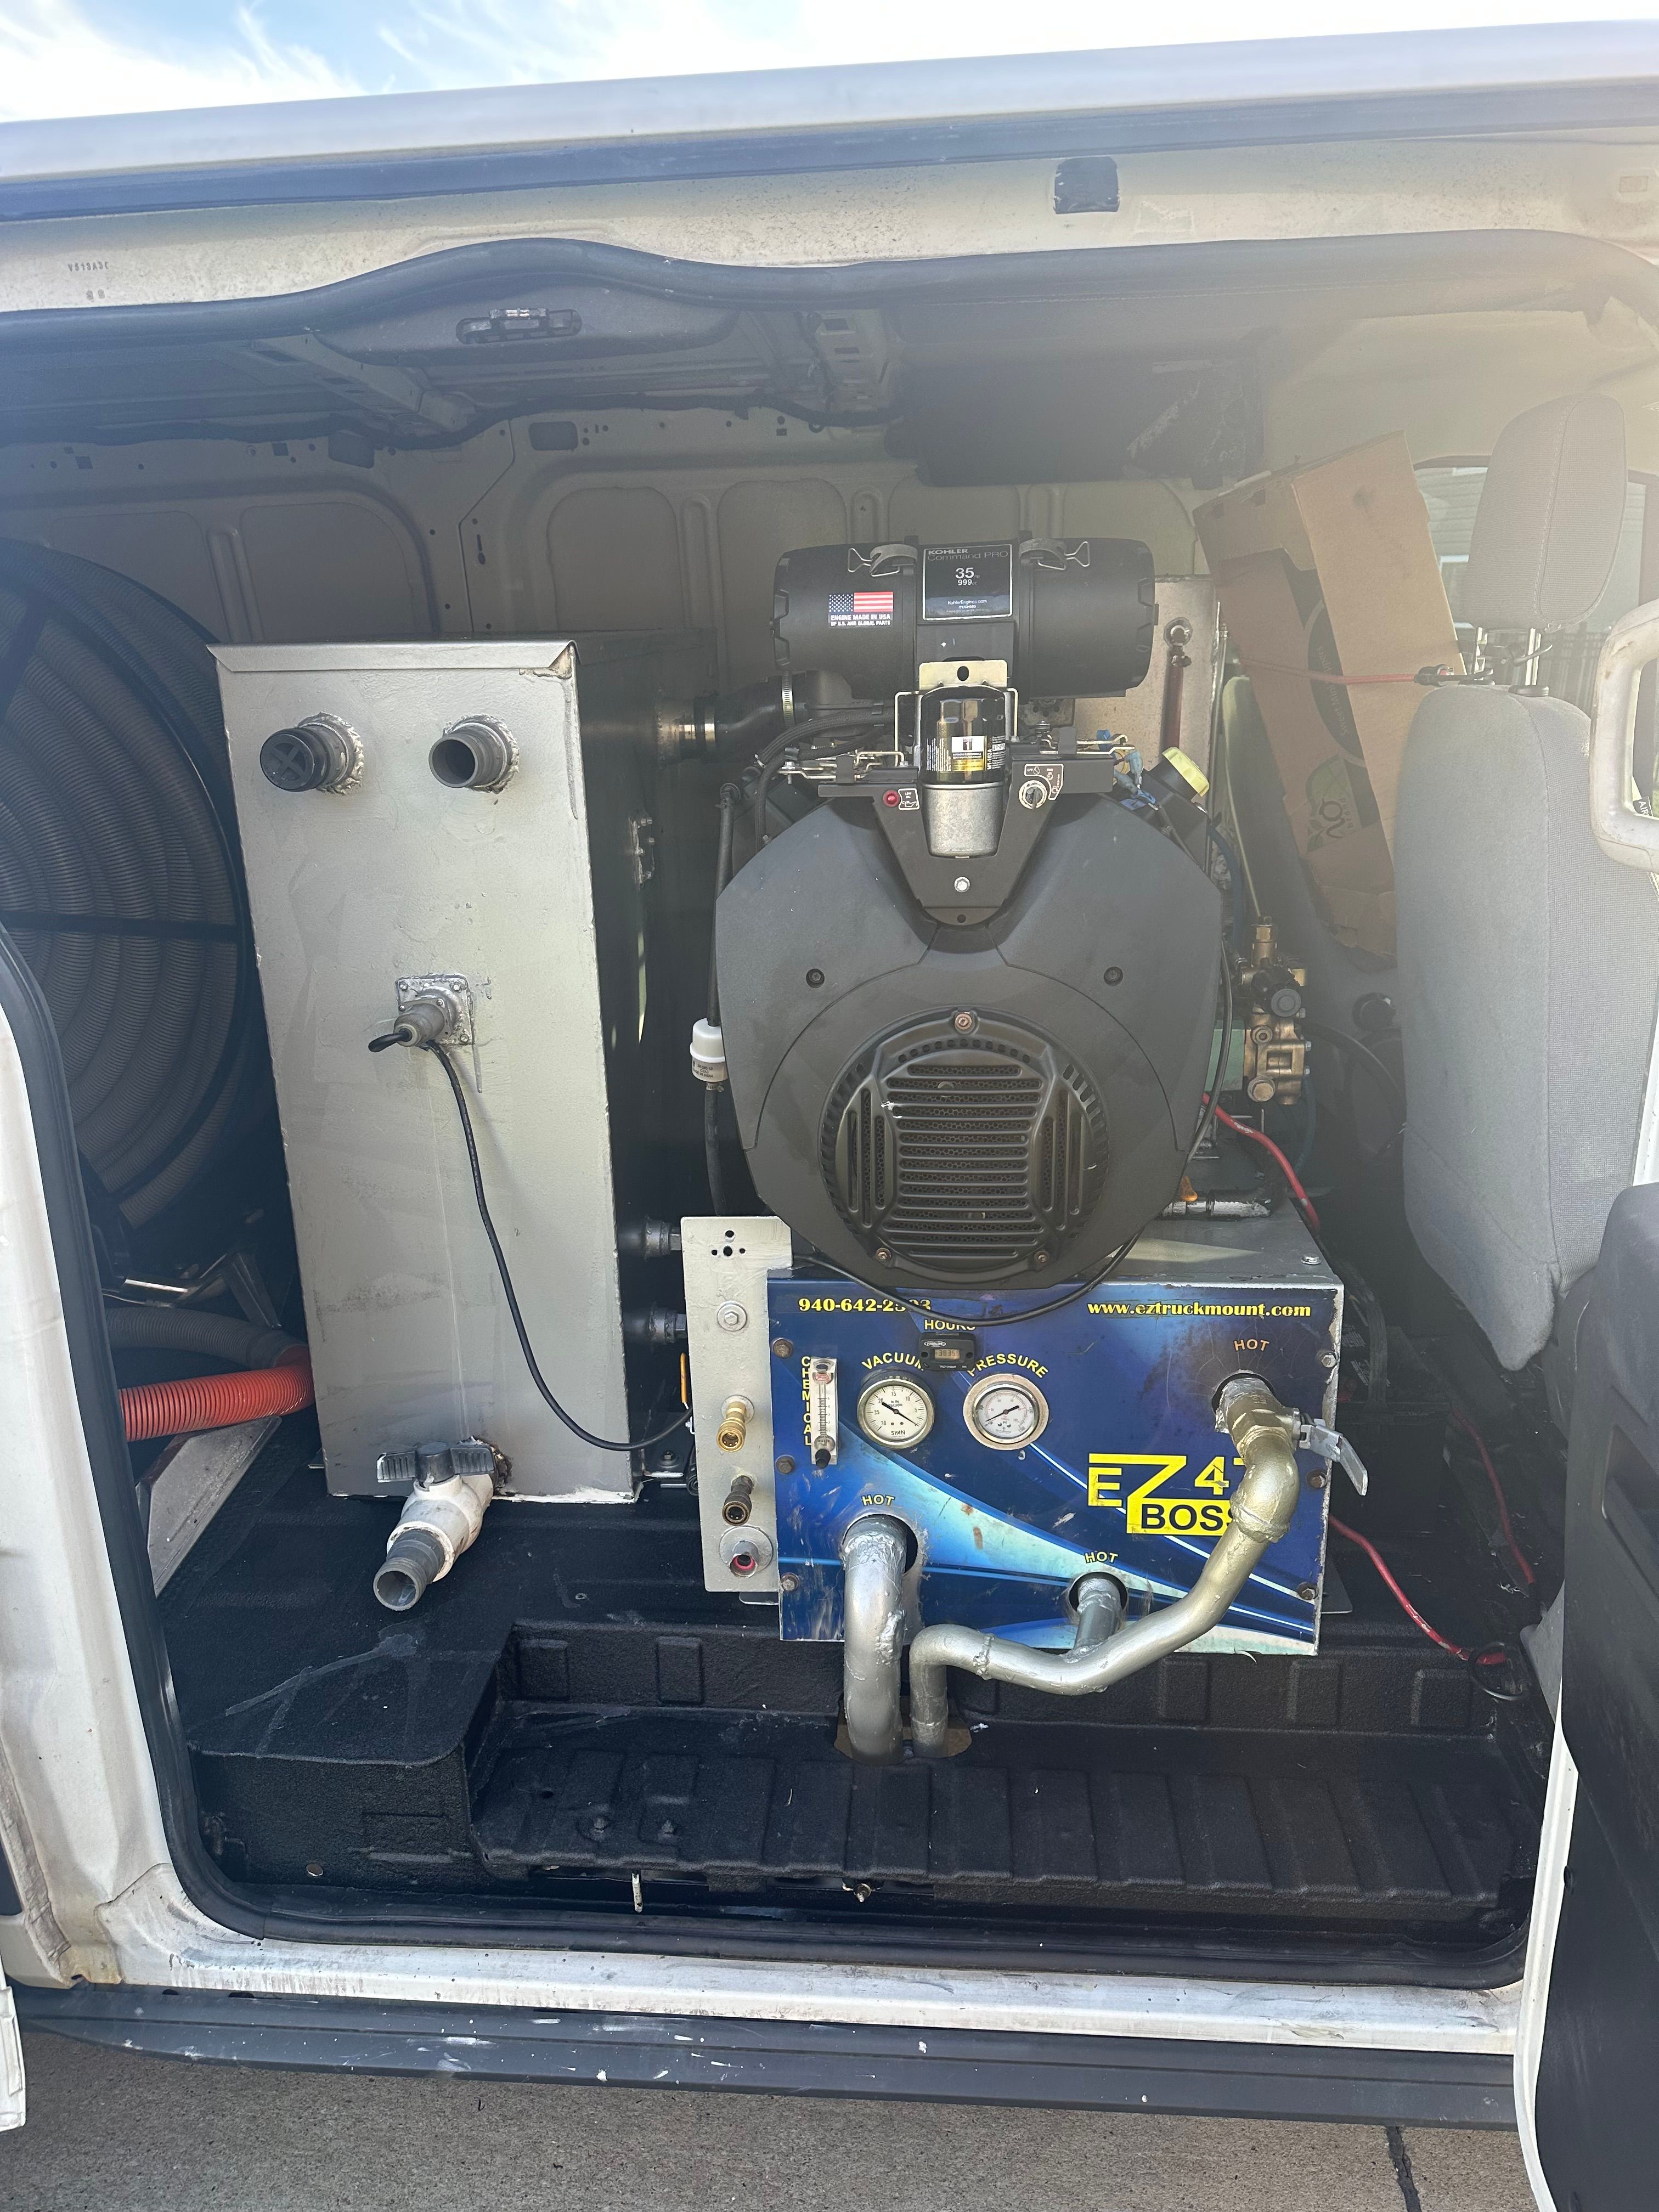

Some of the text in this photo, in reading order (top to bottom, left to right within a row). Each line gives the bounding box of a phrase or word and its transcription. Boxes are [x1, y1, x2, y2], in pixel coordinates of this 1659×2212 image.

[927, 552, 981, 561] Command
[955, 567, 974, 579] 35
[1087, 1302, 1311, 1316] www.eztruckmount.com
[1233, 1339, 1269, 1352] HOT
[862, 1494, 895, 1506] HOT
[1141, 1504, 1233, 1531] BOS
[1084, 1551, 1119, 1564] HOT
